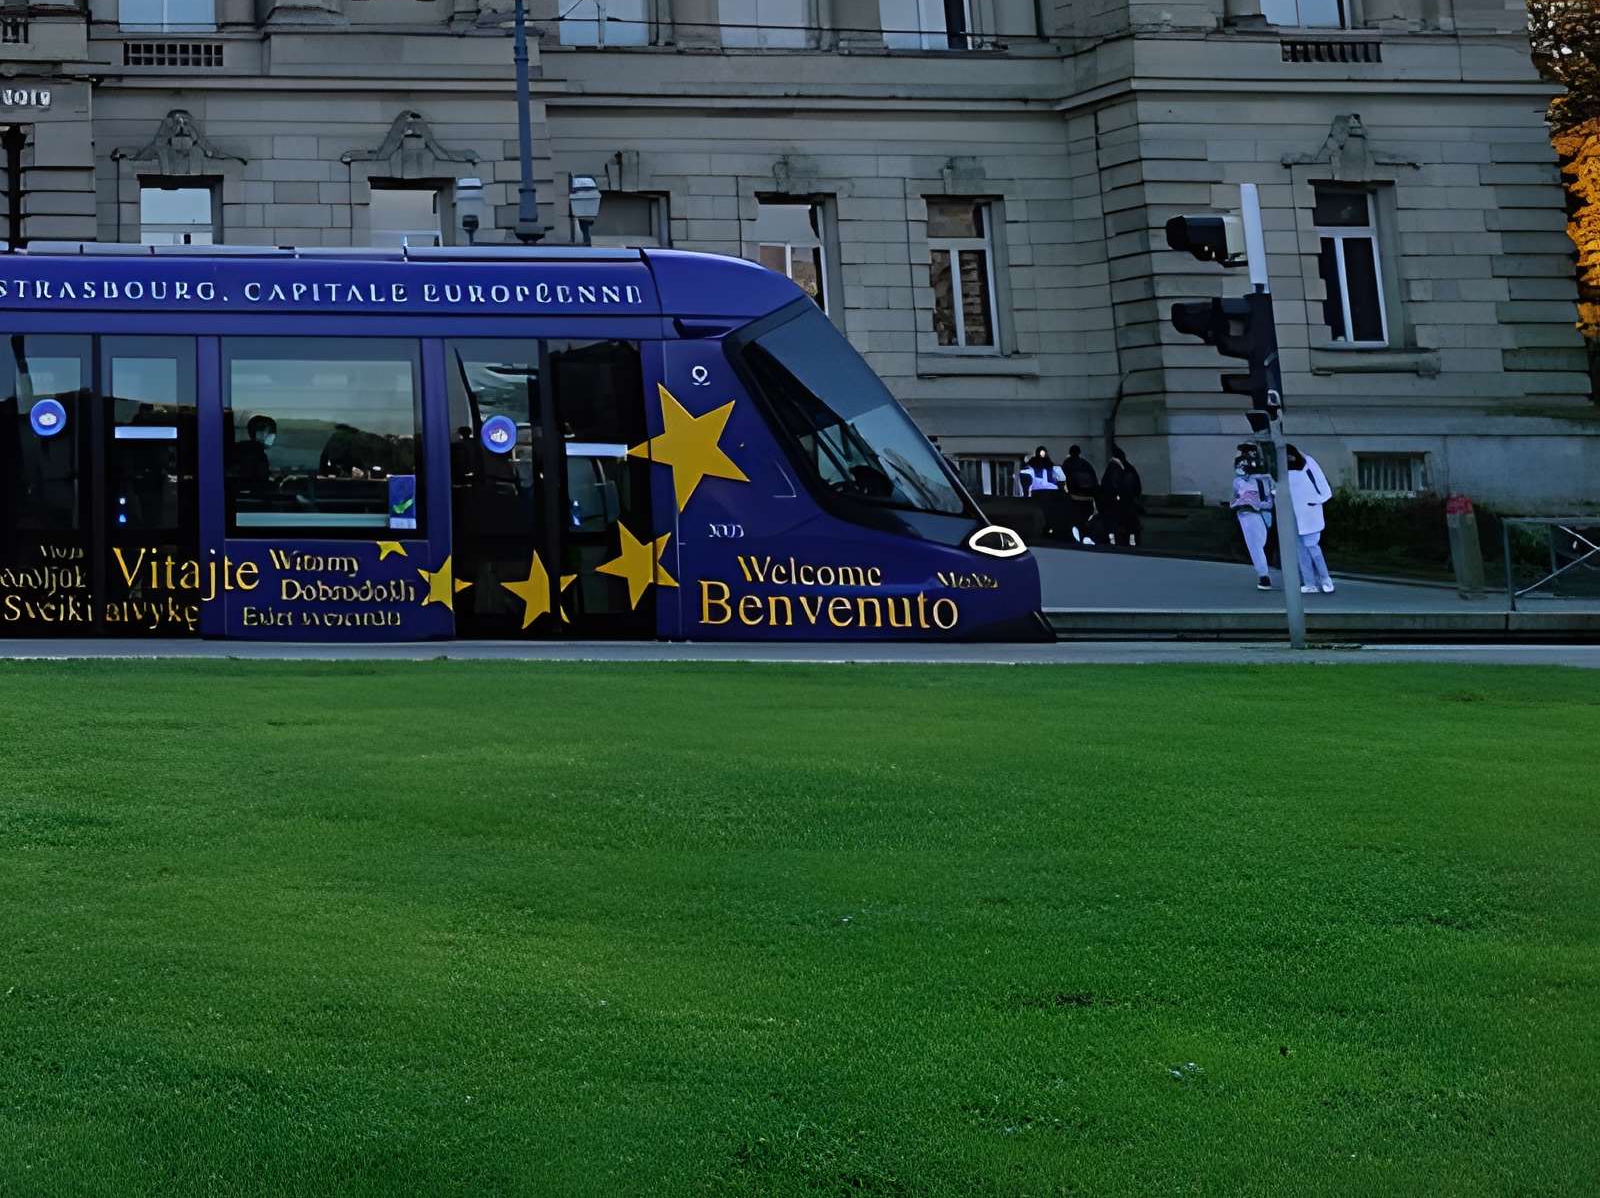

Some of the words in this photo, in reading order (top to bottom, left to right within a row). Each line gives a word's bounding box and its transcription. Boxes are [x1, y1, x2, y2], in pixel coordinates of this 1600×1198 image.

[244, 282, 408, 302] CAPITALE
[112, 546, 260, 601] Vitajte
[736, 555, 882, 587] Welcome
[698, 579, 959, 630] Benvenuto
